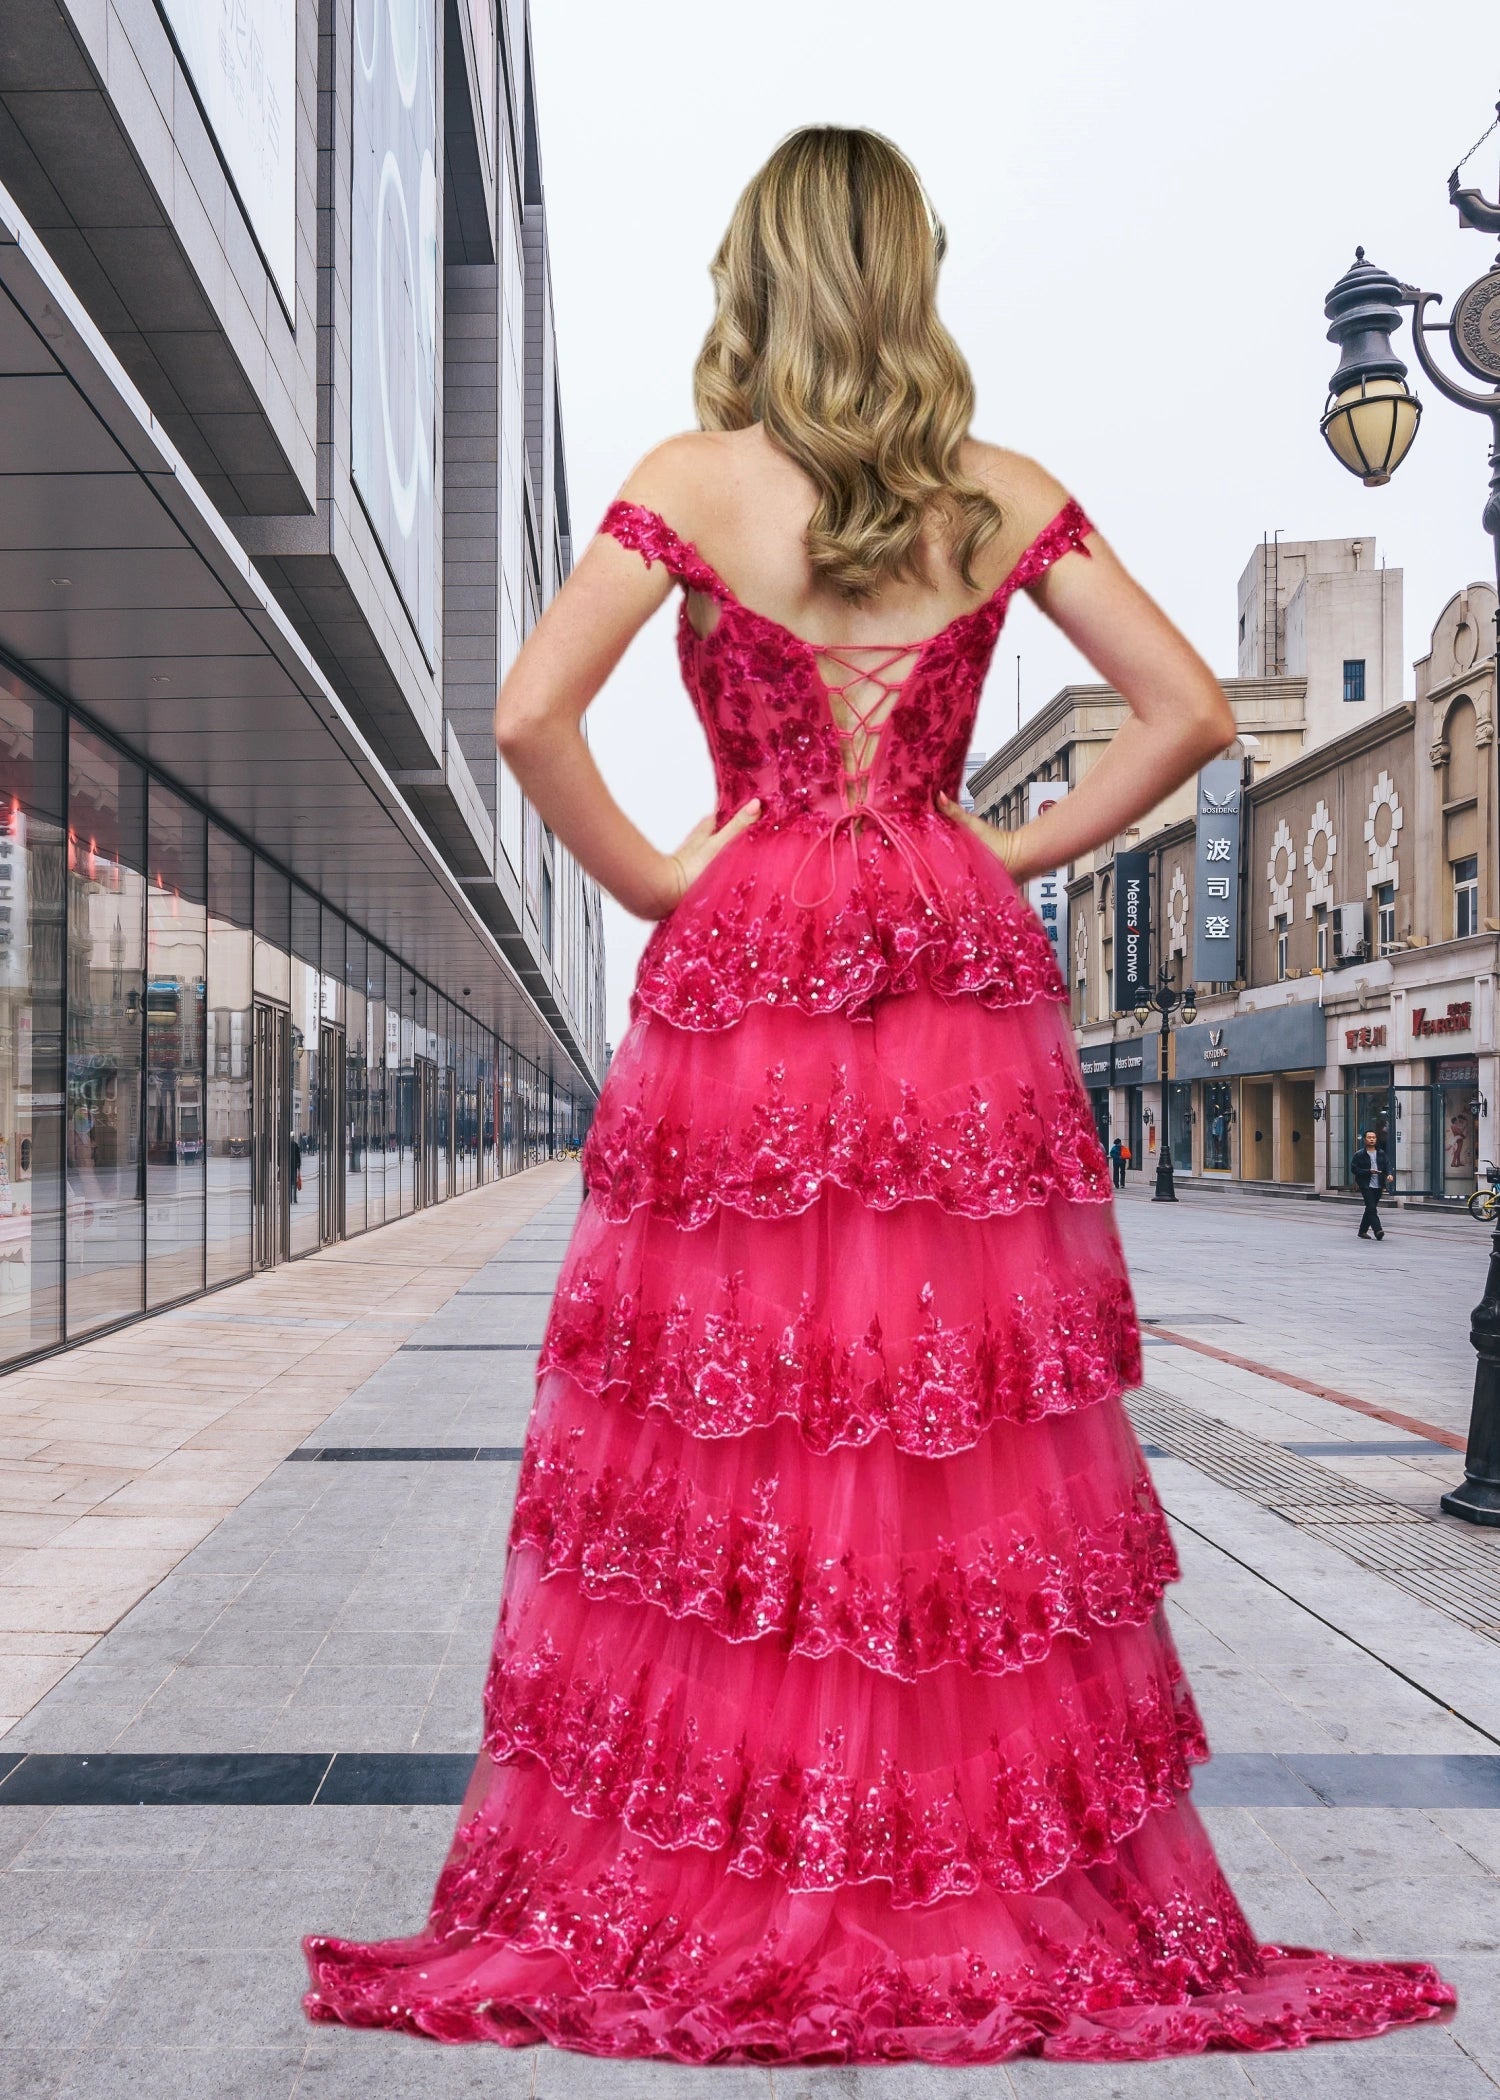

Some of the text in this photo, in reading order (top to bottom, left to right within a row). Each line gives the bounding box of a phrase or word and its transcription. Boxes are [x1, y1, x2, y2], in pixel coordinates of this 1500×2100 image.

[1202, 806, 1239, 814] BOSIDENG
[1127, 879, 1140, 983] Meters/bonwe
[1205, 837, 1232, 940] 波司登
